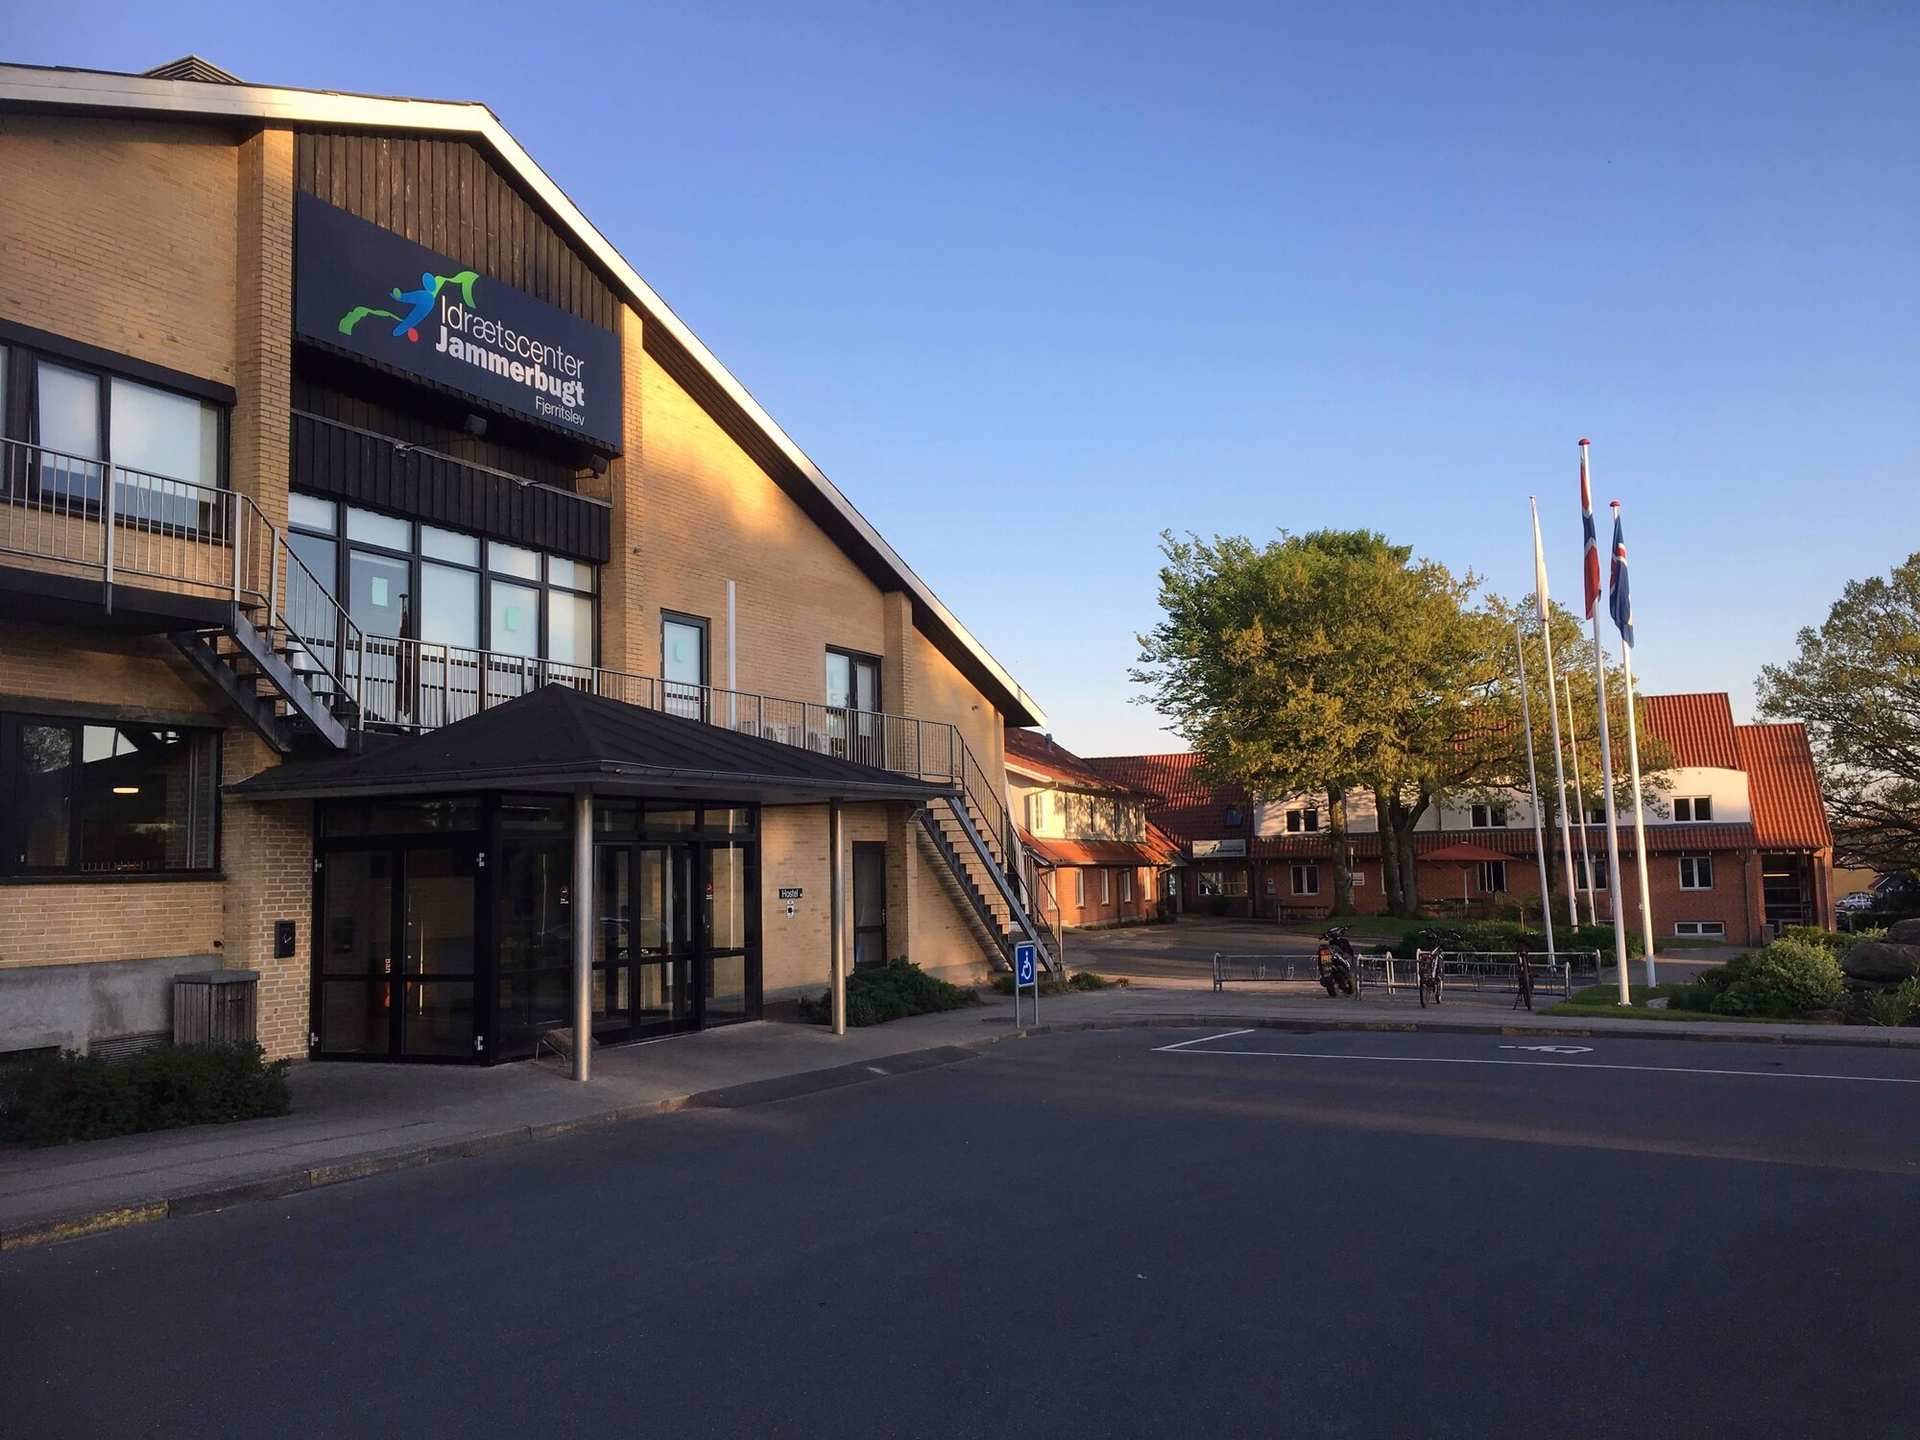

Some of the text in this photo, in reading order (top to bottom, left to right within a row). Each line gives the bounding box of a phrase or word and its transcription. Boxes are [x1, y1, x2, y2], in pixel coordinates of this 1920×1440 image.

[436, 325, 584, 408] Jammerbugt
[442, 296, 584, 379] Idrætscenter
[536, 396, 585, 425] Fjerritslev
